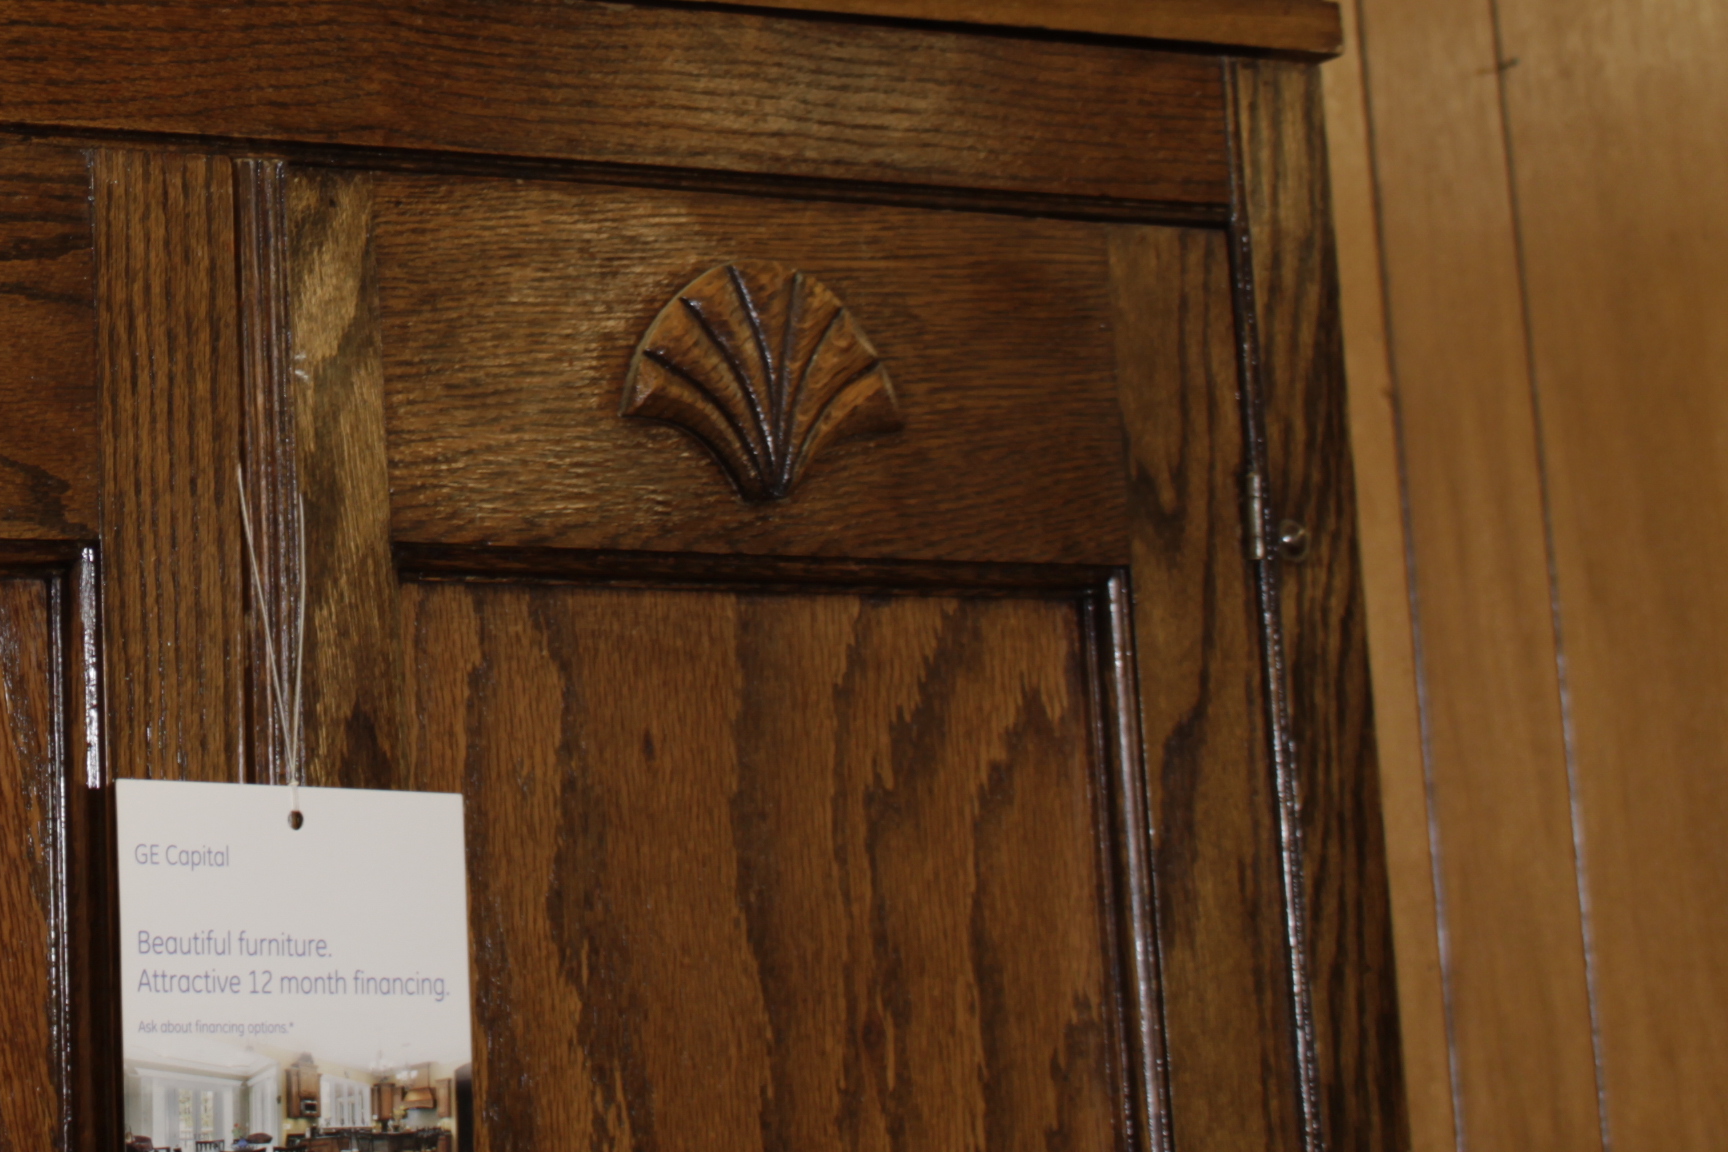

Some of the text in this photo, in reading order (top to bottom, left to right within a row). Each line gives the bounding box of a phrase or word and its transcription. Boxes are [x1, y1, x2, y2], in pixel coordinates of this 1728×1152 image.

[134, 843, 230, 871] GE Capital
[137, 929, 333, 958] Beautiful furniture.
[137, 968, 450, 1001] Attractive 12 month financing.
[137, 1020, 158, 1034] Ask
[160, 1020, 193, 1034] about
[195, 1020, 245, 1037] financing
